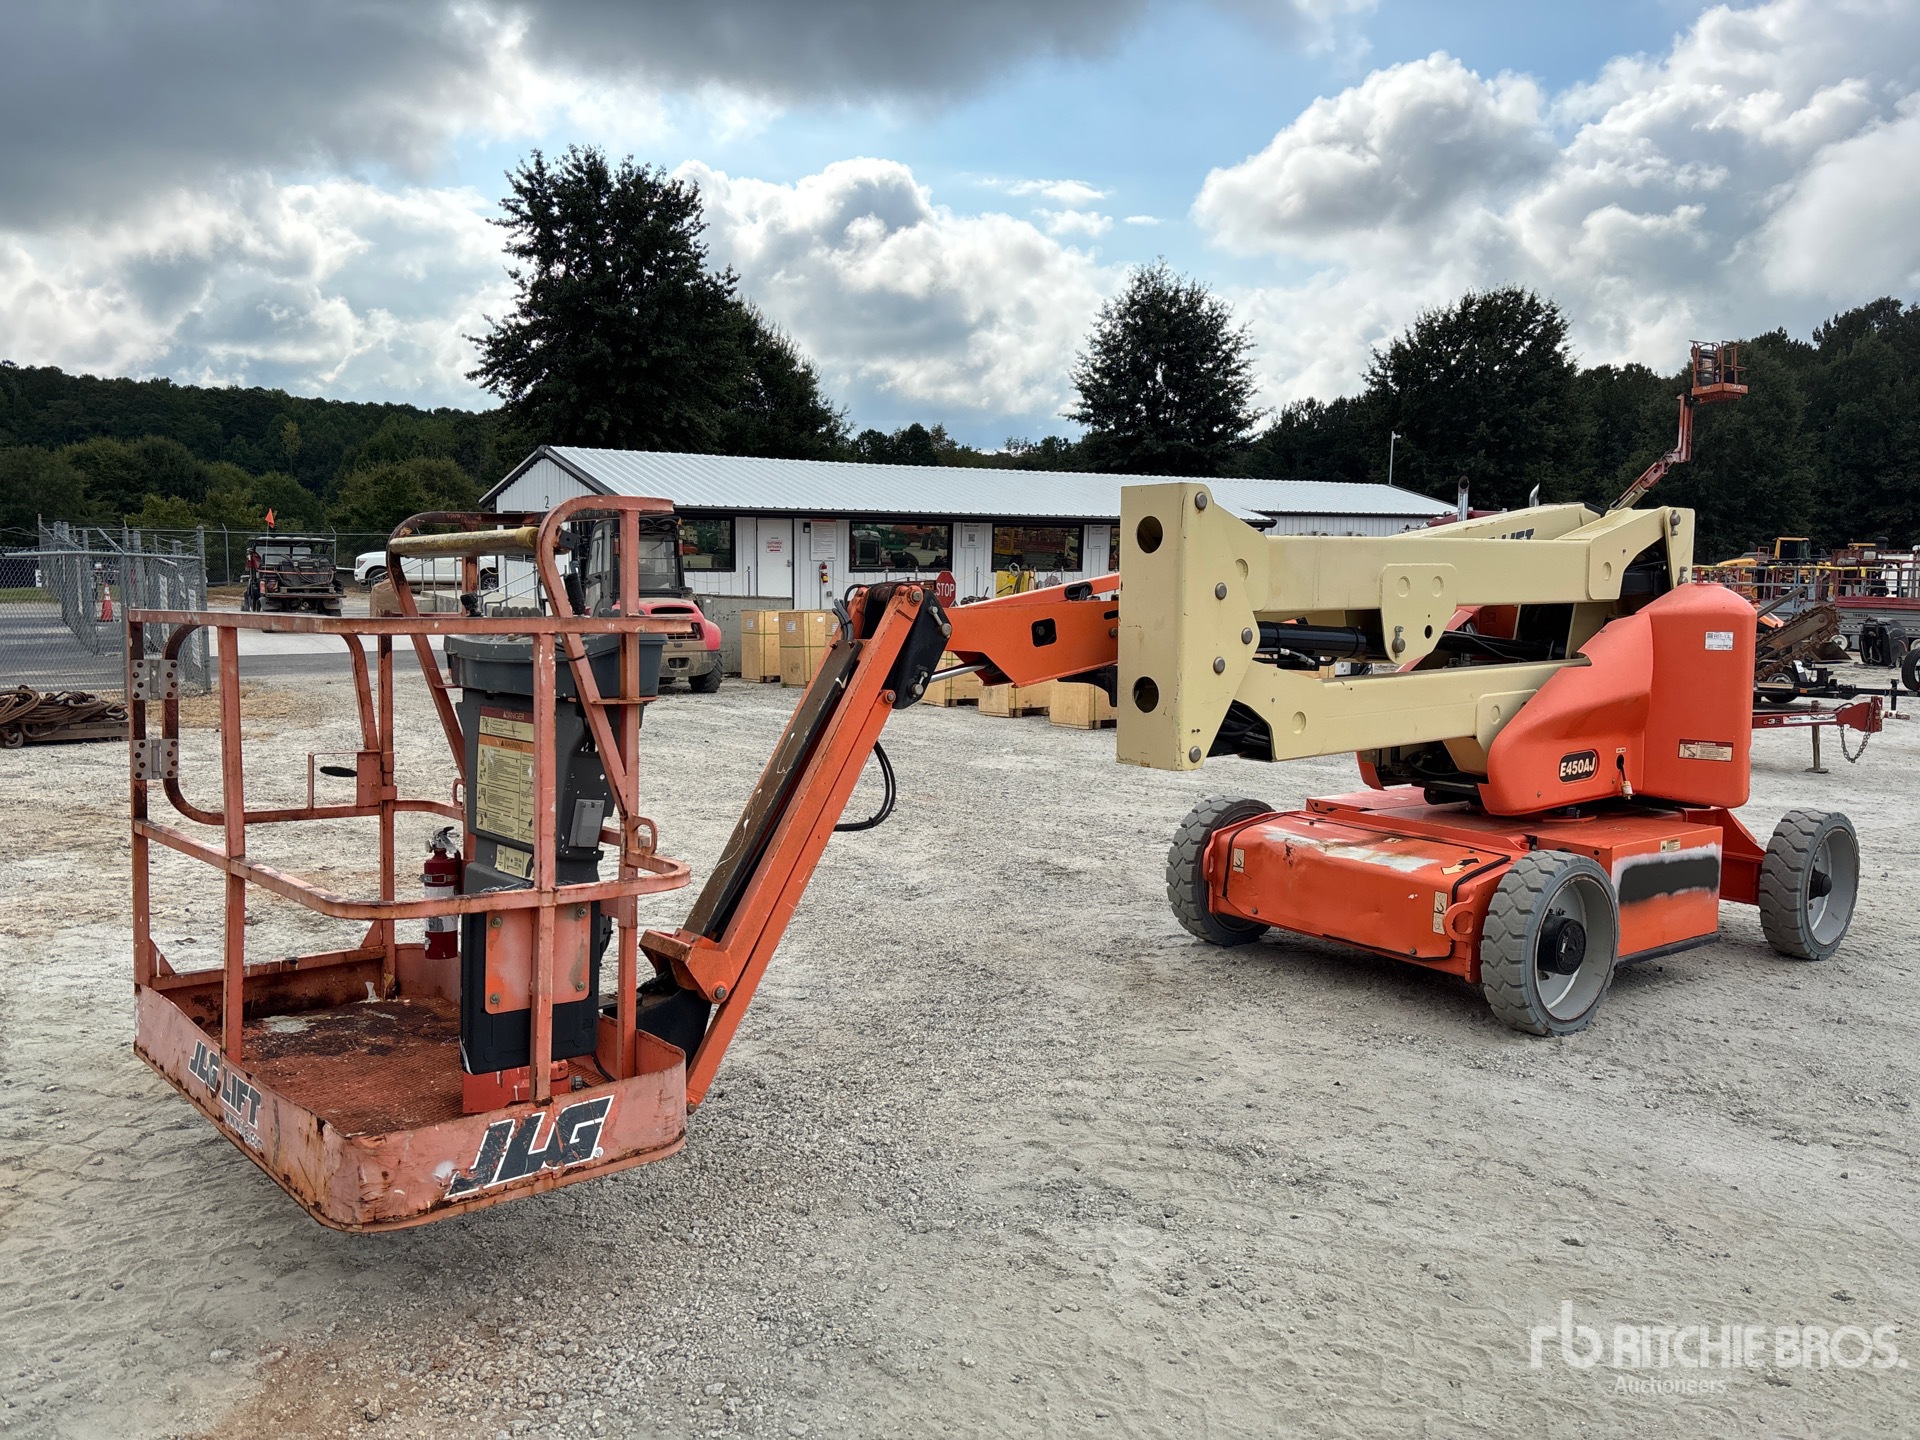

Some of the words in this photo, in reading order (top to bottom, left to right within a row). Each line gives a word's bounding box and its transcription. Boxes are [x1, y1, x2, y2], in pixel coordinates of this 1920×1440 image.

[544, 495, 550, 509] 2
[936, 582, 955, 597] STOP
[505, 711, 525, 721] DANGER
[505, 741, 524, 750] WARNING
[1560, 756, 1596, 777] E450AJ
[188, 1039, 220, 1093] JLG
[220, 1064, 262, 1129] LIFT
[443, 1094, 615, 1199] JLG
